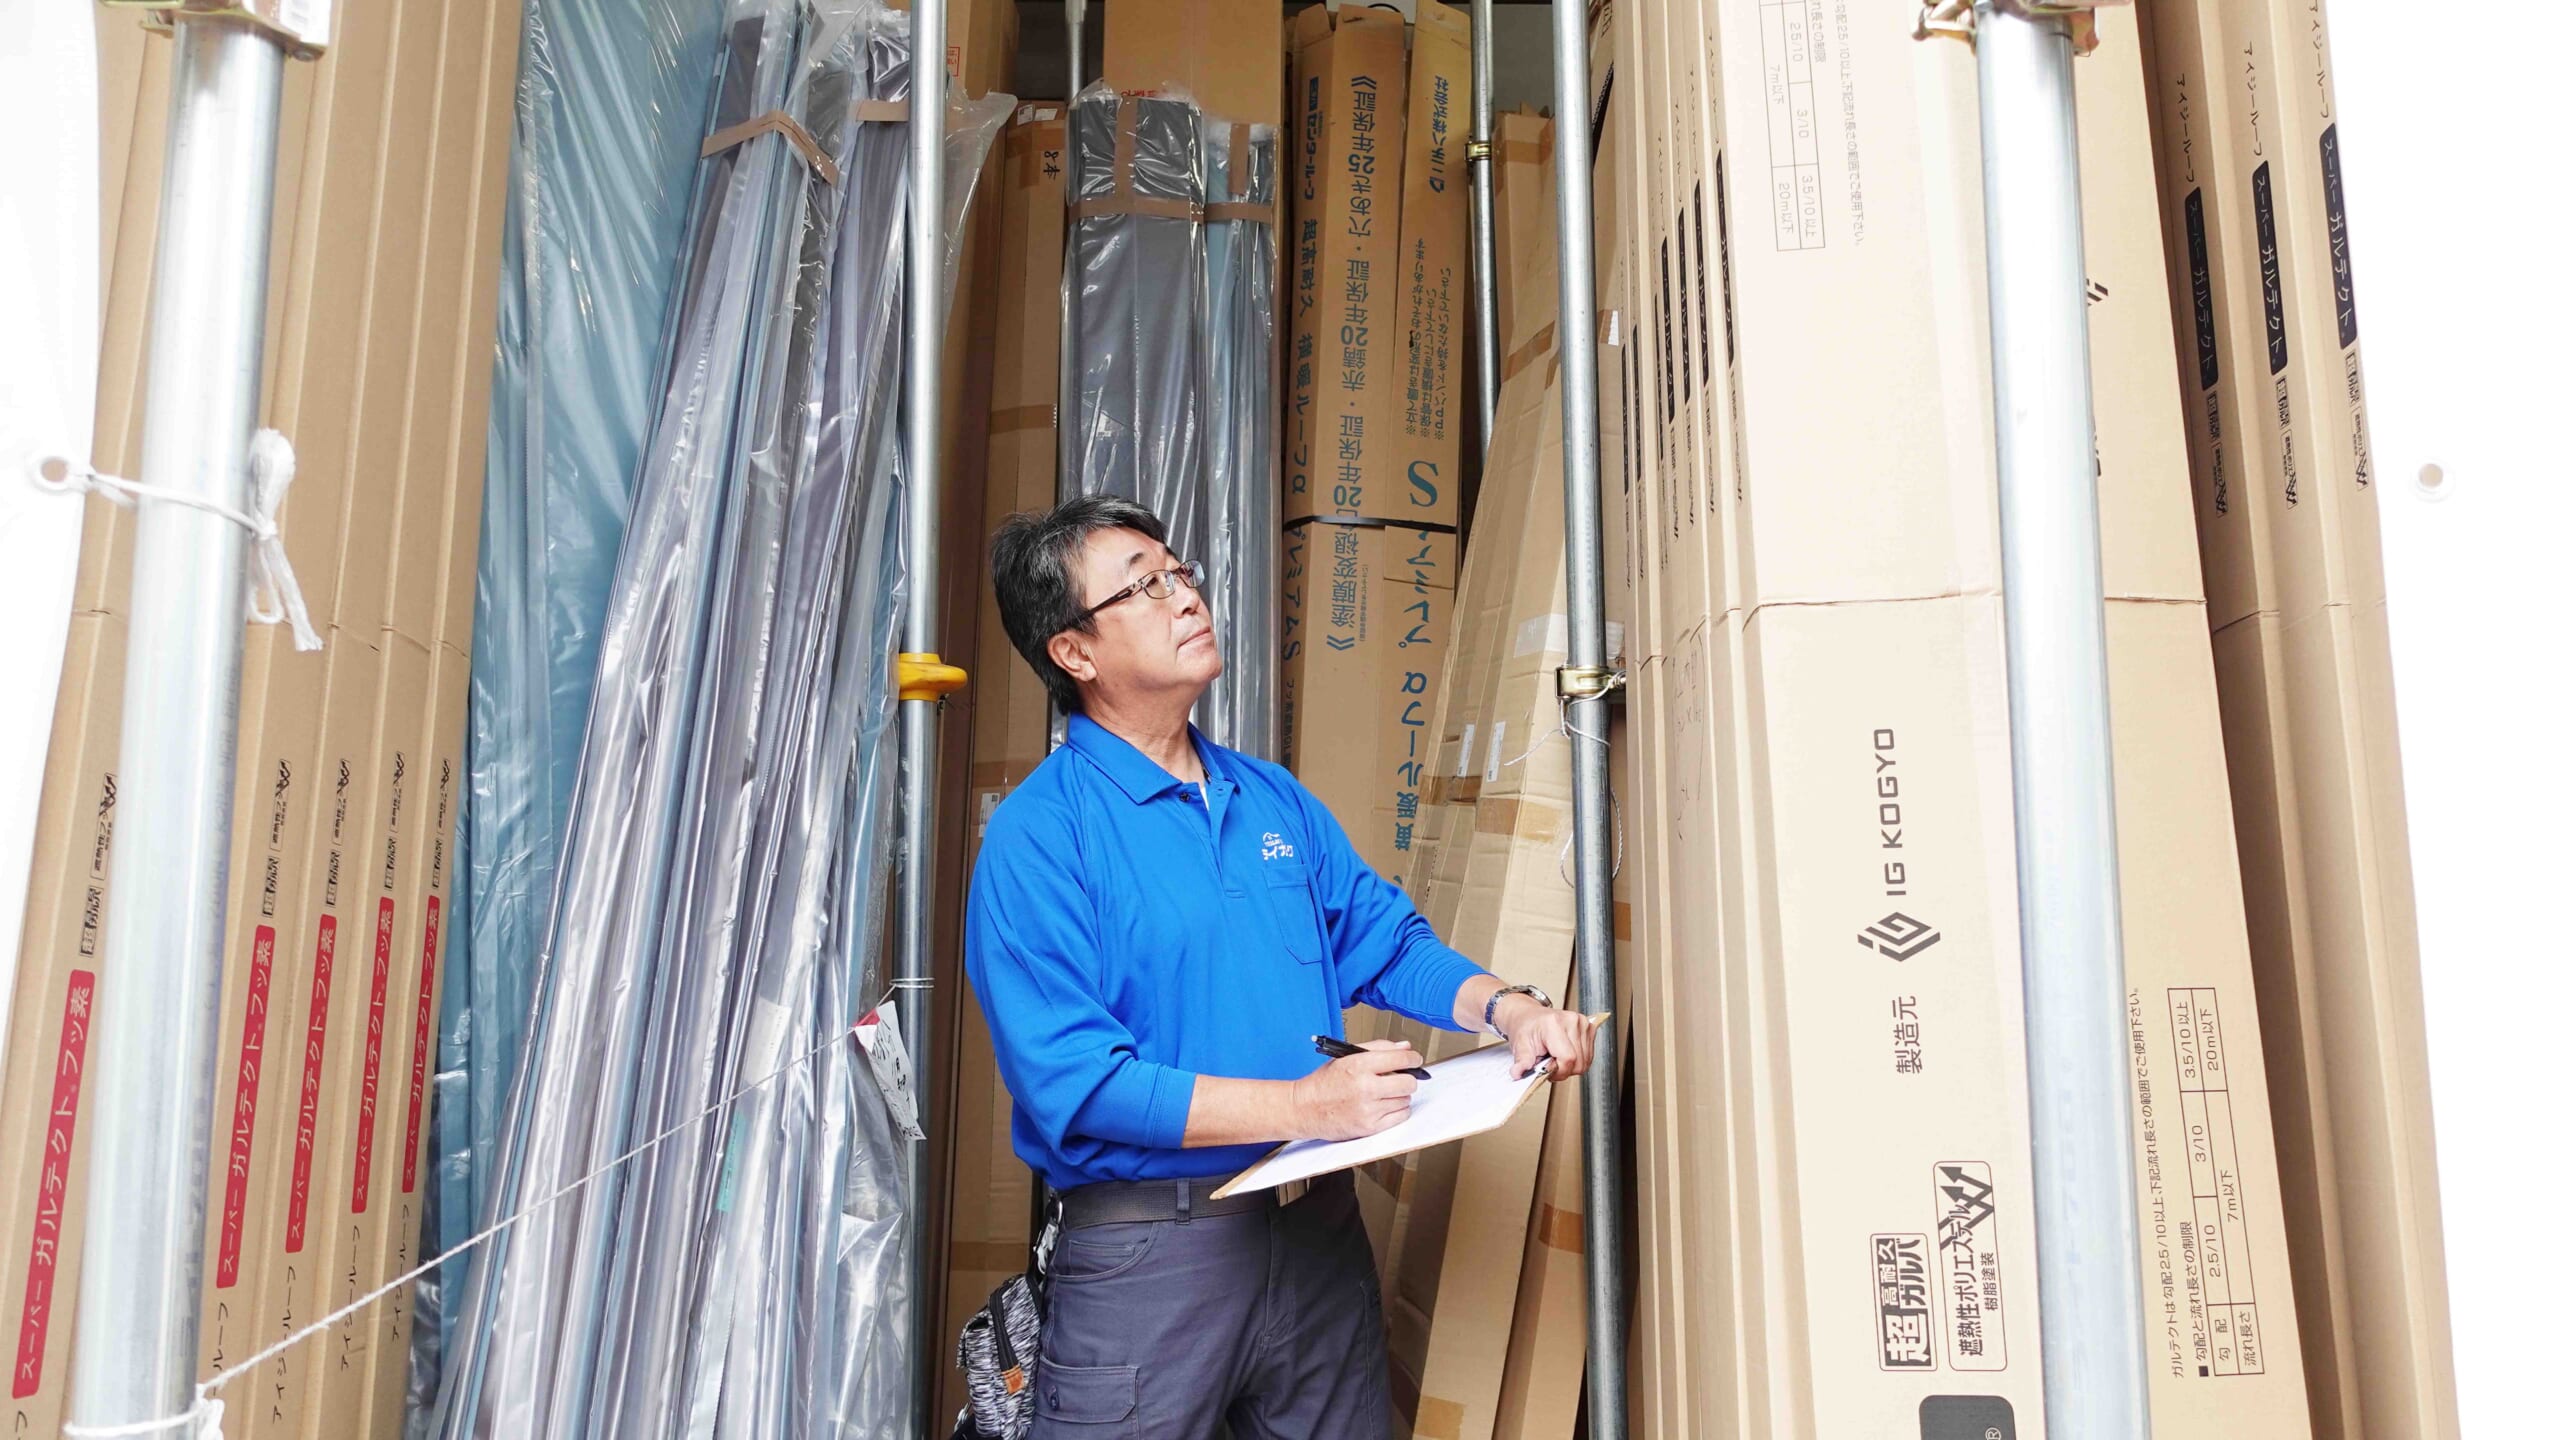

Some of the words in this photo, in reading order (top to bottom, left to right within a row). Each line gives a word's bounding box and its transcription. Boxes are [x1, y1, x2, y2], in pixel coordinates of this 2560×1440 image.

[1807, 1, 1828, 64] れ長さの制限
[1797, 110, 1809, 138] 3/10
[2262, 245, 2287, 353] ガルテクト
[2330, 212, 2352, 330] ガルテクト
[1873, 728, 1904, 849] KOGYO
[1884, 862, 1906, 897] IG
[1894, 996, 1924, 1075] 製造元
[2200, 1009, 2218, 1070] 20m以下
[2192, 1126, 2206, 1162] 3/10
[2221, 1170, 2238, 1222] 7m以下
[1896, 1238, 1928, 1307] ガルバ
[1949, 1203, 1982, 1356] 遮熱性ポリエステル
[1979, 1251, 2001, 1312] 樹脂塗装
[2204, 1225, 2220, 1277] 2.5/10
[2180, 1222, 2207, 1361] 勾配と流れ長さの制限
[2239, 1312, 2256, 1365] 流れ長さ
[15, 1410, 27, 1440] フ
